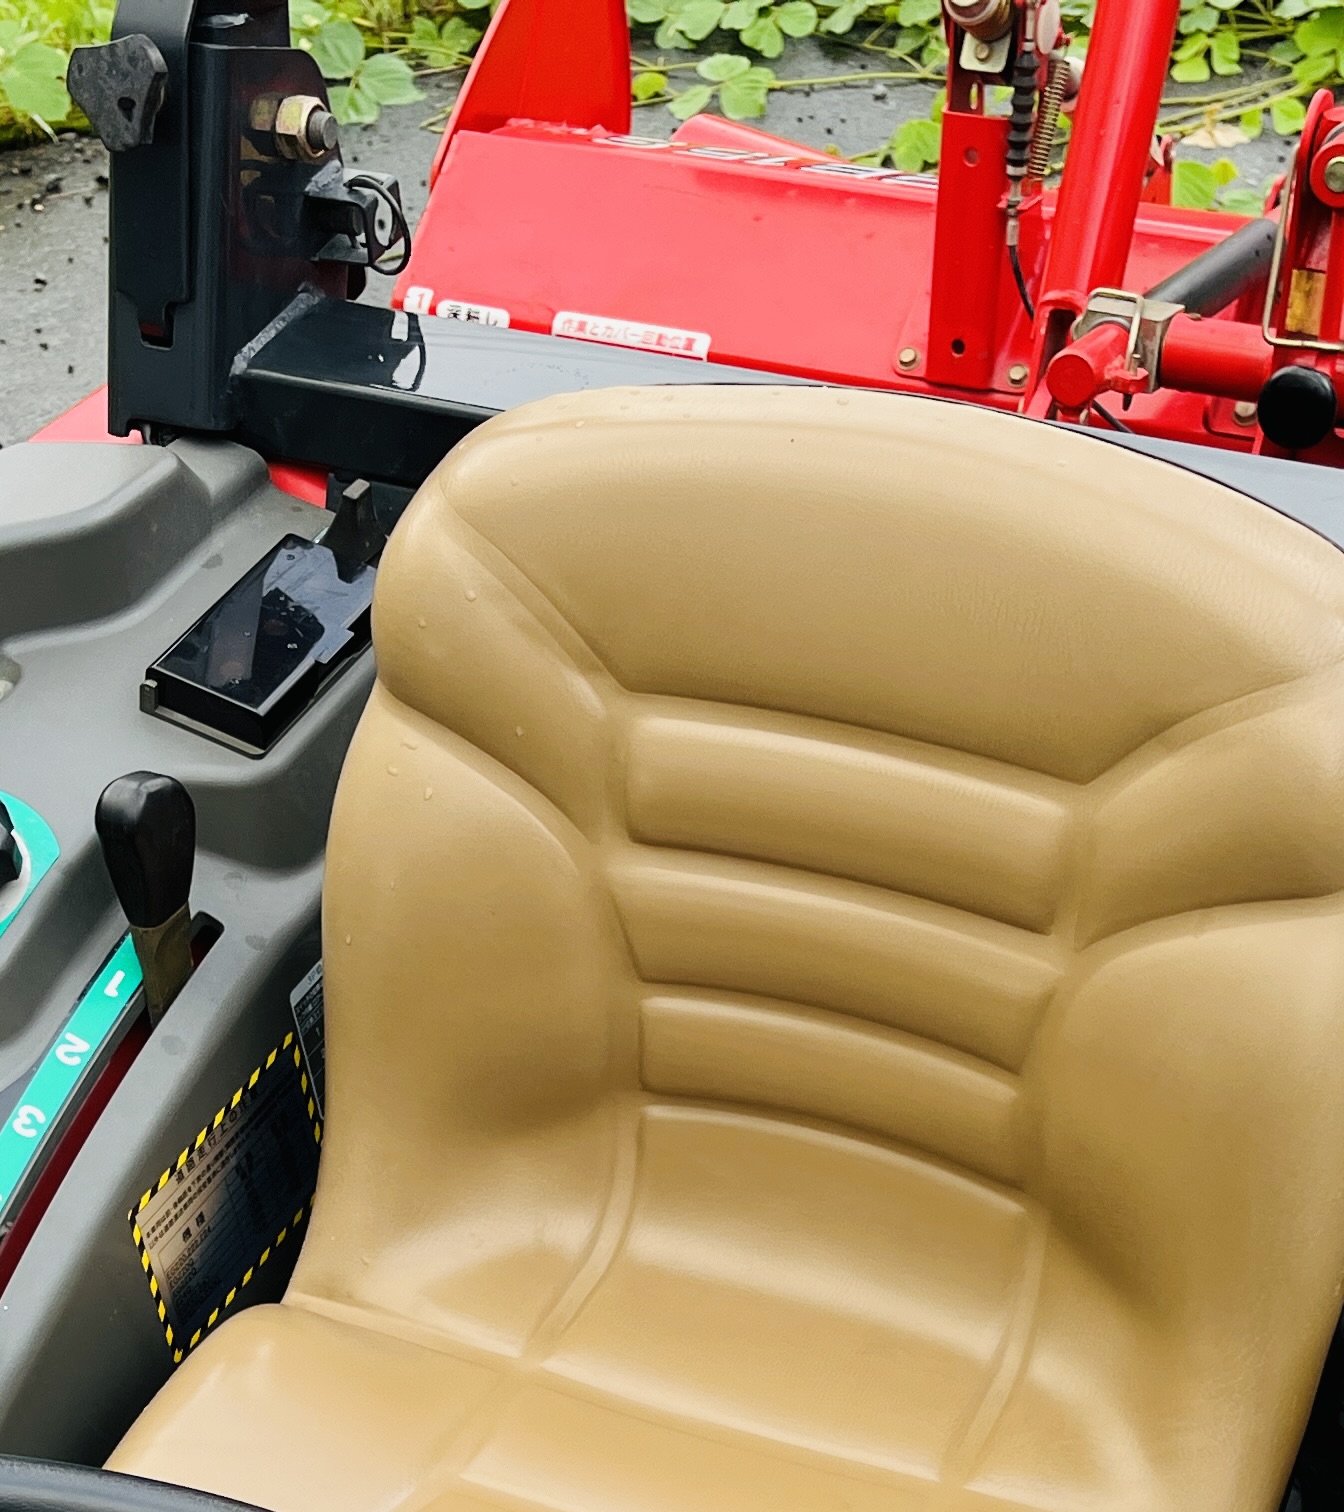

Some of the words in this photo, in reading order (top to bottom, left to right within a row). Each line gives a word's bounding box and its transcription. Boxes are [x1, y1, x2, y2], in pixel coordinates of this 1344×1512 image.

[103, 971, 126, 998] 1
[56, 1032, 90, 1066] 2
[12, 1104, 46, 1138] 3
